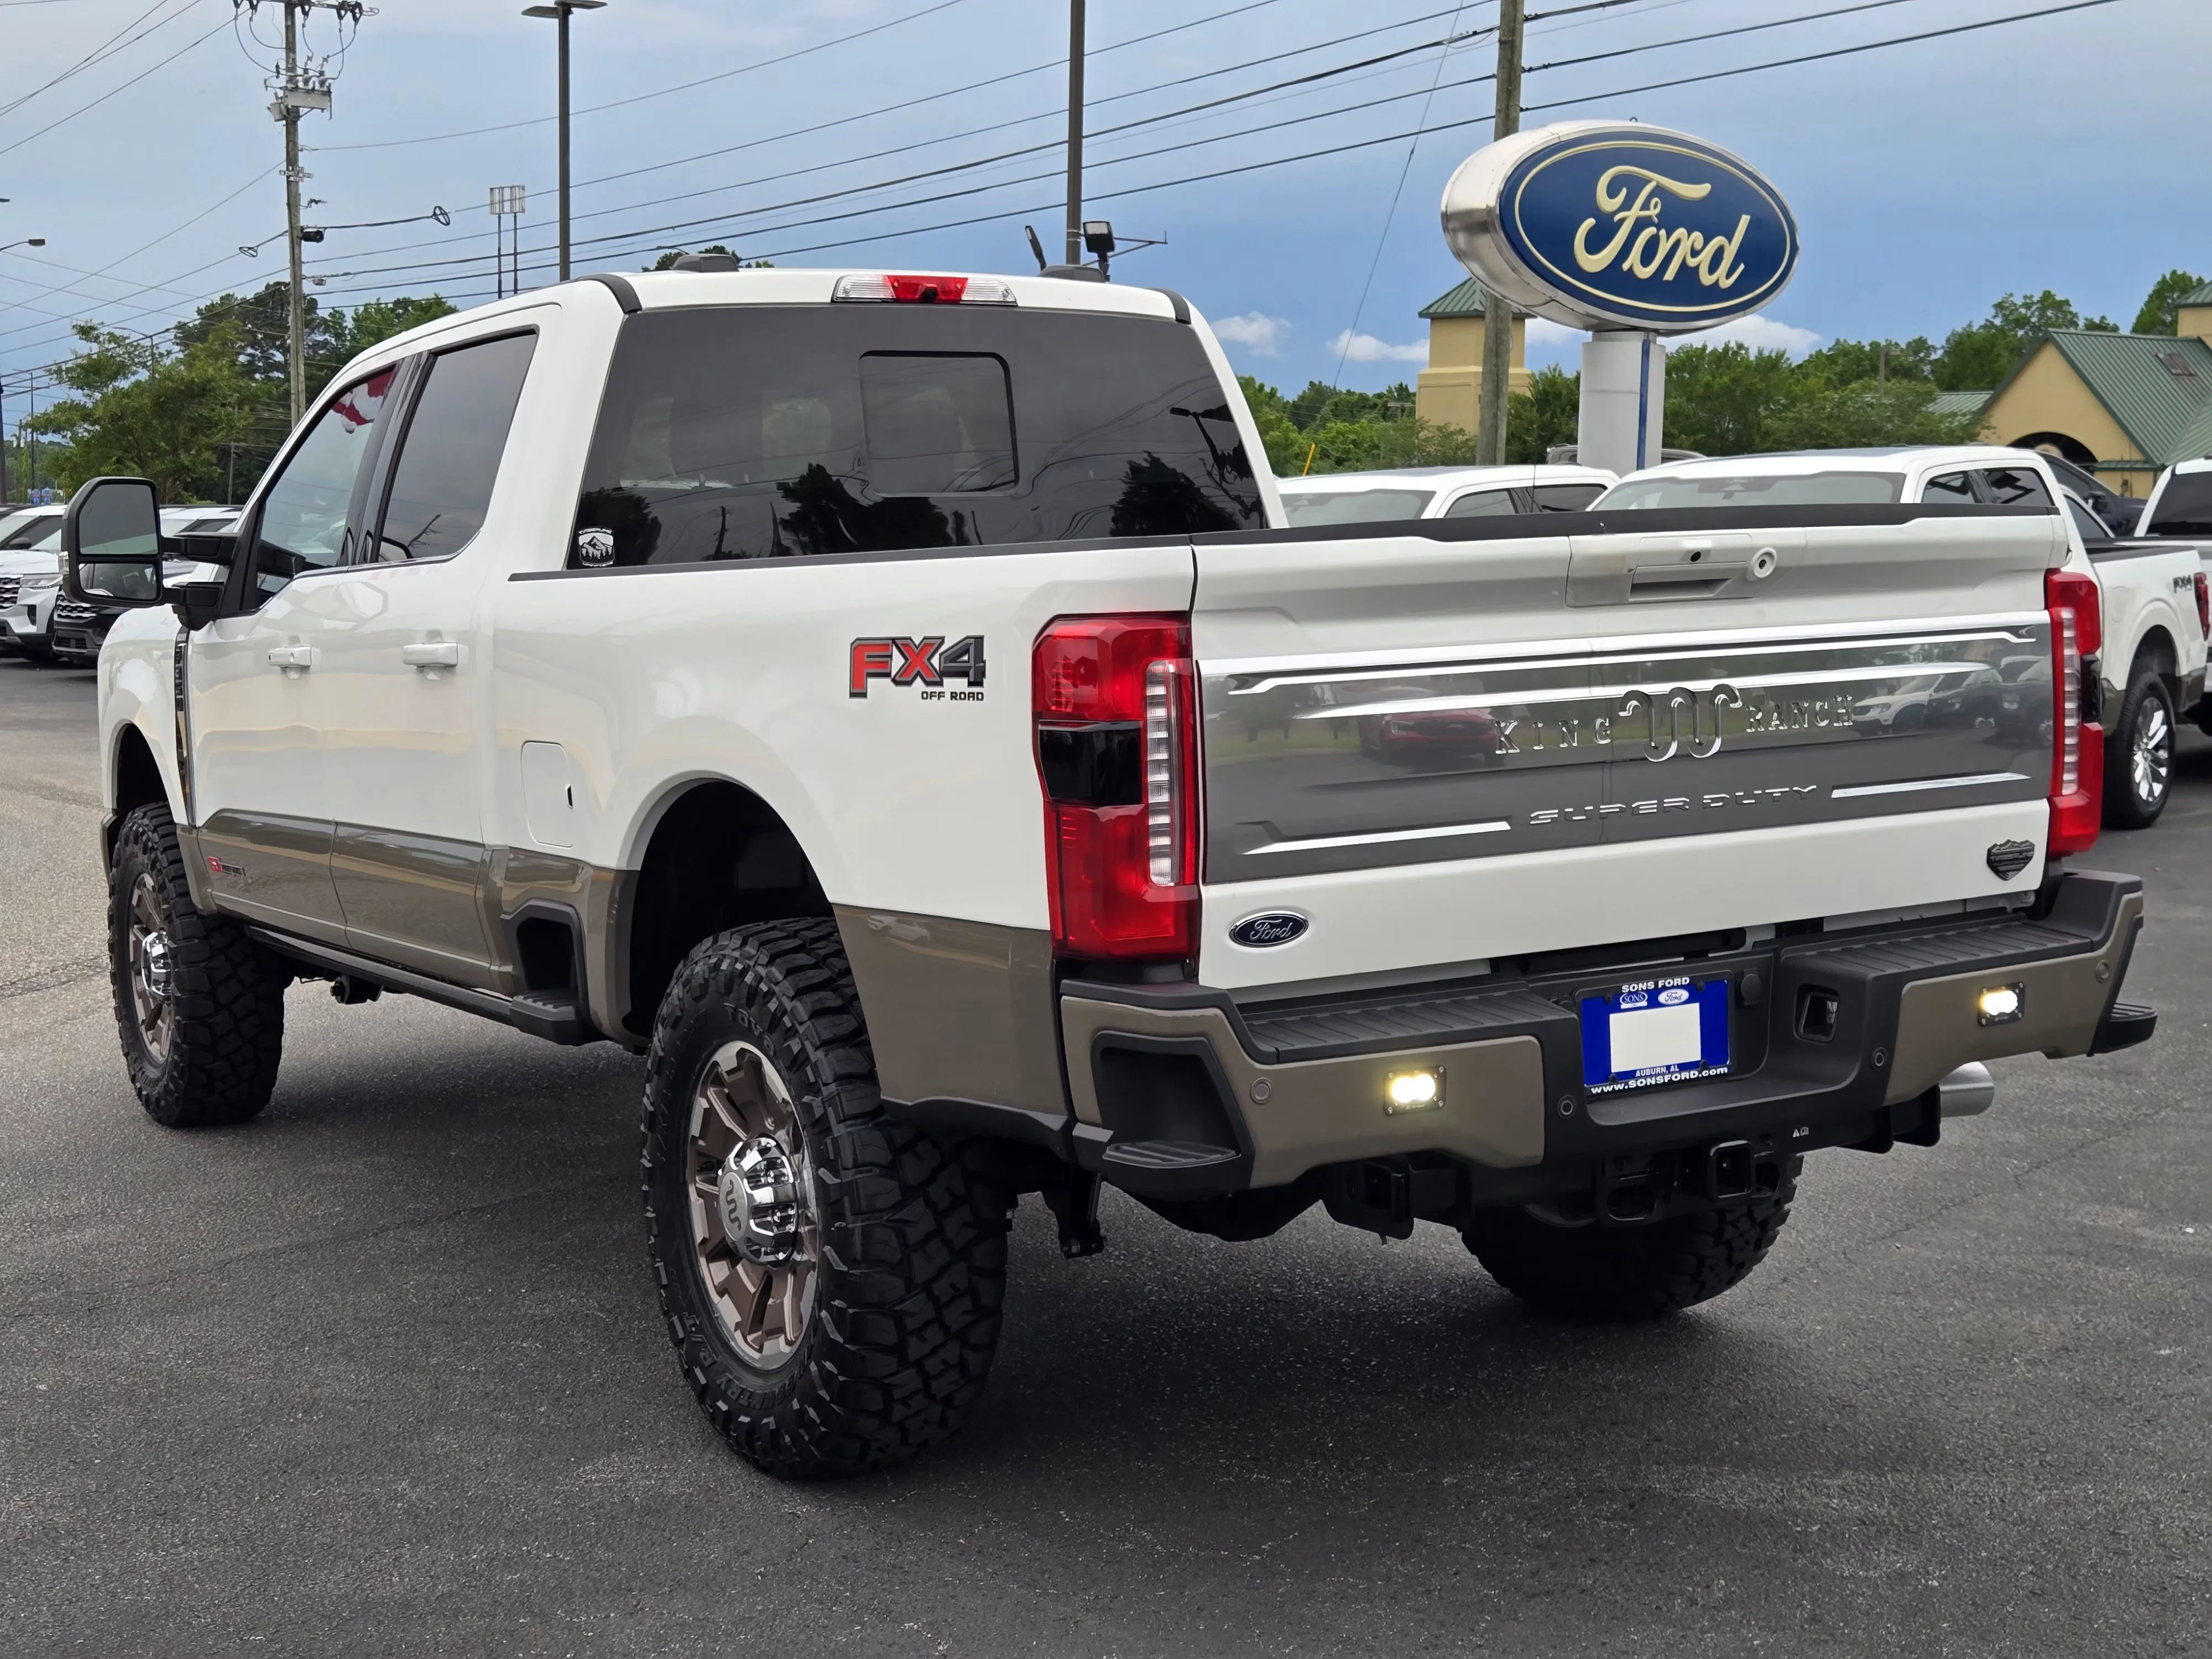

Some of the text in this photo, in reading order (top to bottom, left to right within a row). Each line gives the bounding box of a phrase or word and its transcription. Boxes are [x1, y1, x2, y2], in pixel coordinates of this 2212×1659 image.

[1573, 165, 1751, 289] Ford
[849, 635, 987, 699] FX4
[921, 691, 984, 701] OFF ROAD
[1494, 695, 1853, 754] KING RANCH
[1530, 785, 1817, 824] SUPER DUTY
[1250, 919, 1293, 940] Ford
[1621, 977, 1690, 993] SONS FORD
[1665, 992, 1683, 1002] Ford
[1624, 994, 1644, 1003] SONS
[723, 1002, 775, 1057] TOYO
[1591, 1067, 1728, 1094] www.SONSFORD.com
[1636, 1067, 1668, 1077] AUBURN,
